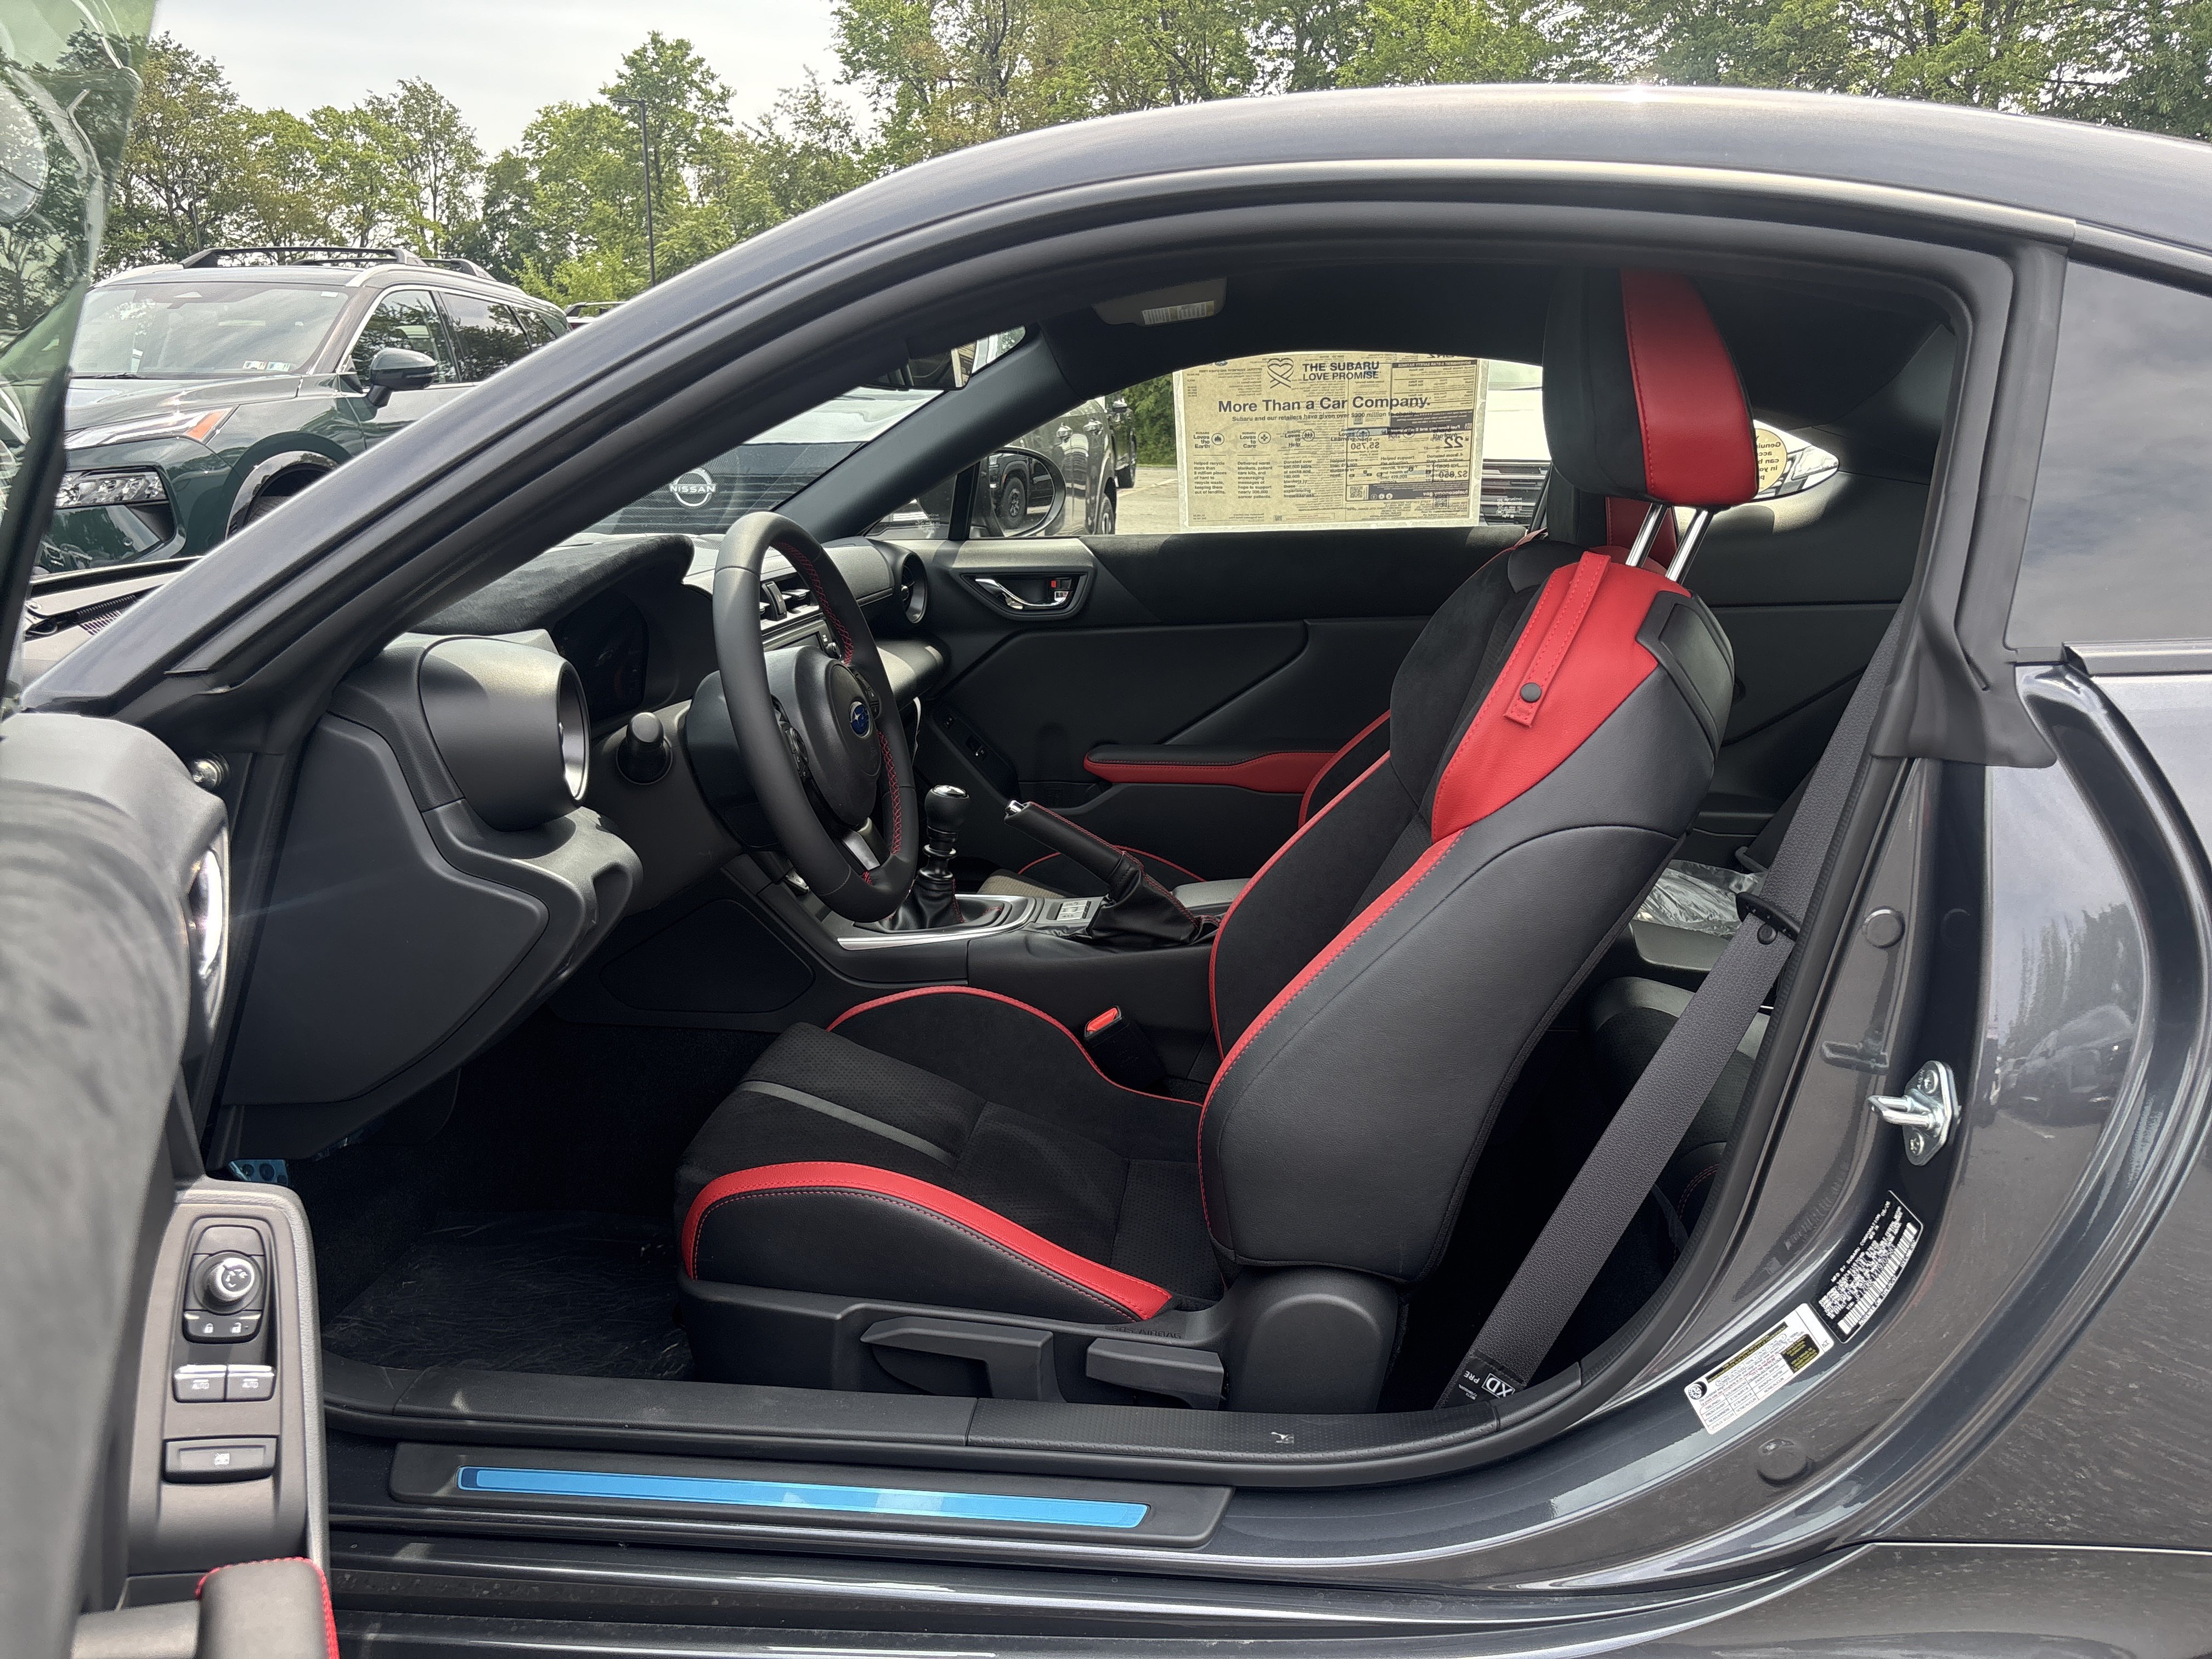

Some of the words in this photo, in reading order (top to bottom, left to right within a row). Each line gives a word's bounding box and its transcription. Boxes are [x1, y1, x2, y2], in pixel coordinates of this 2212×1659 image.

[1302, 363, 1327, 372] THE
[1330, 362, 1379, 371] SUBARU
[1303, 373, 1329, 381] LOVE
[1332, 371, 1379, 380] PROMISE
[1218, 400, 1257, 413] More
[1262, 399, 1300, 411] Than
[1306, 400, 1314, 409] a
[1320, 397, 1347, 409] Car
[1352, 396, 1430, 410] Company.
[1845, 1246, 1861, 1265] SUBARU
[1859, 1213, 1881, 1246] CORPORATION
[1138, 1329, 1181, 1339] AIRBAG
[1463, 1370, 1480, 1384] PRE
[1486, 1377, 1513, 1397] XD
